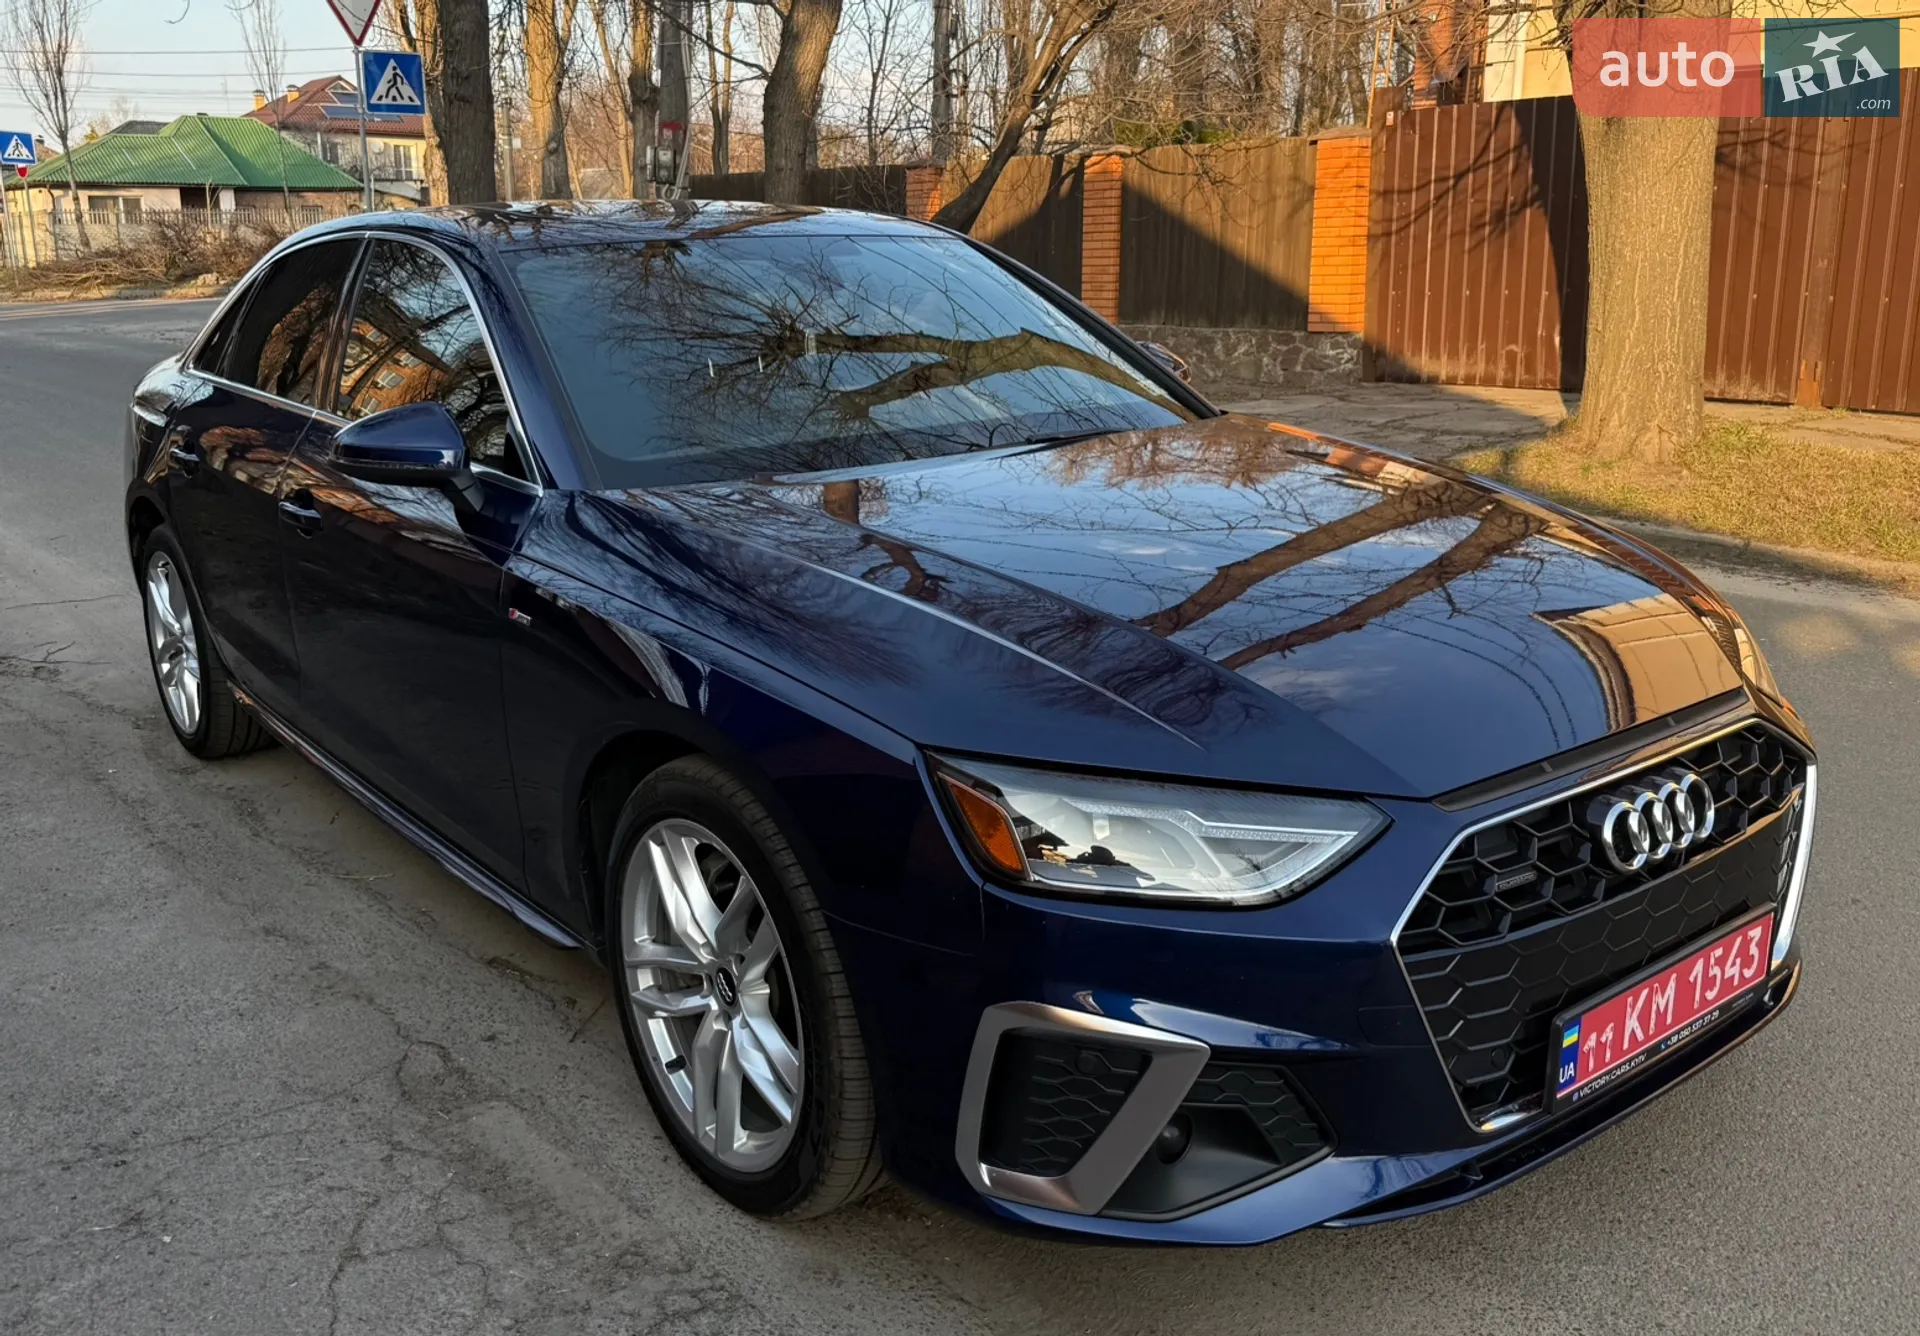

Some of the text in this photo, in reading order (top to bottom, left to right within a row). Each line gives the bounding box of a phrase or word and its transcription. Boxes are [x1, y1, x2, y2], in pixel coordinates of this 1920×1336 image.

[1583, 926, 1763, 1073] 11 KM 1543
[1559, 1062, 1575, 1084] UA
